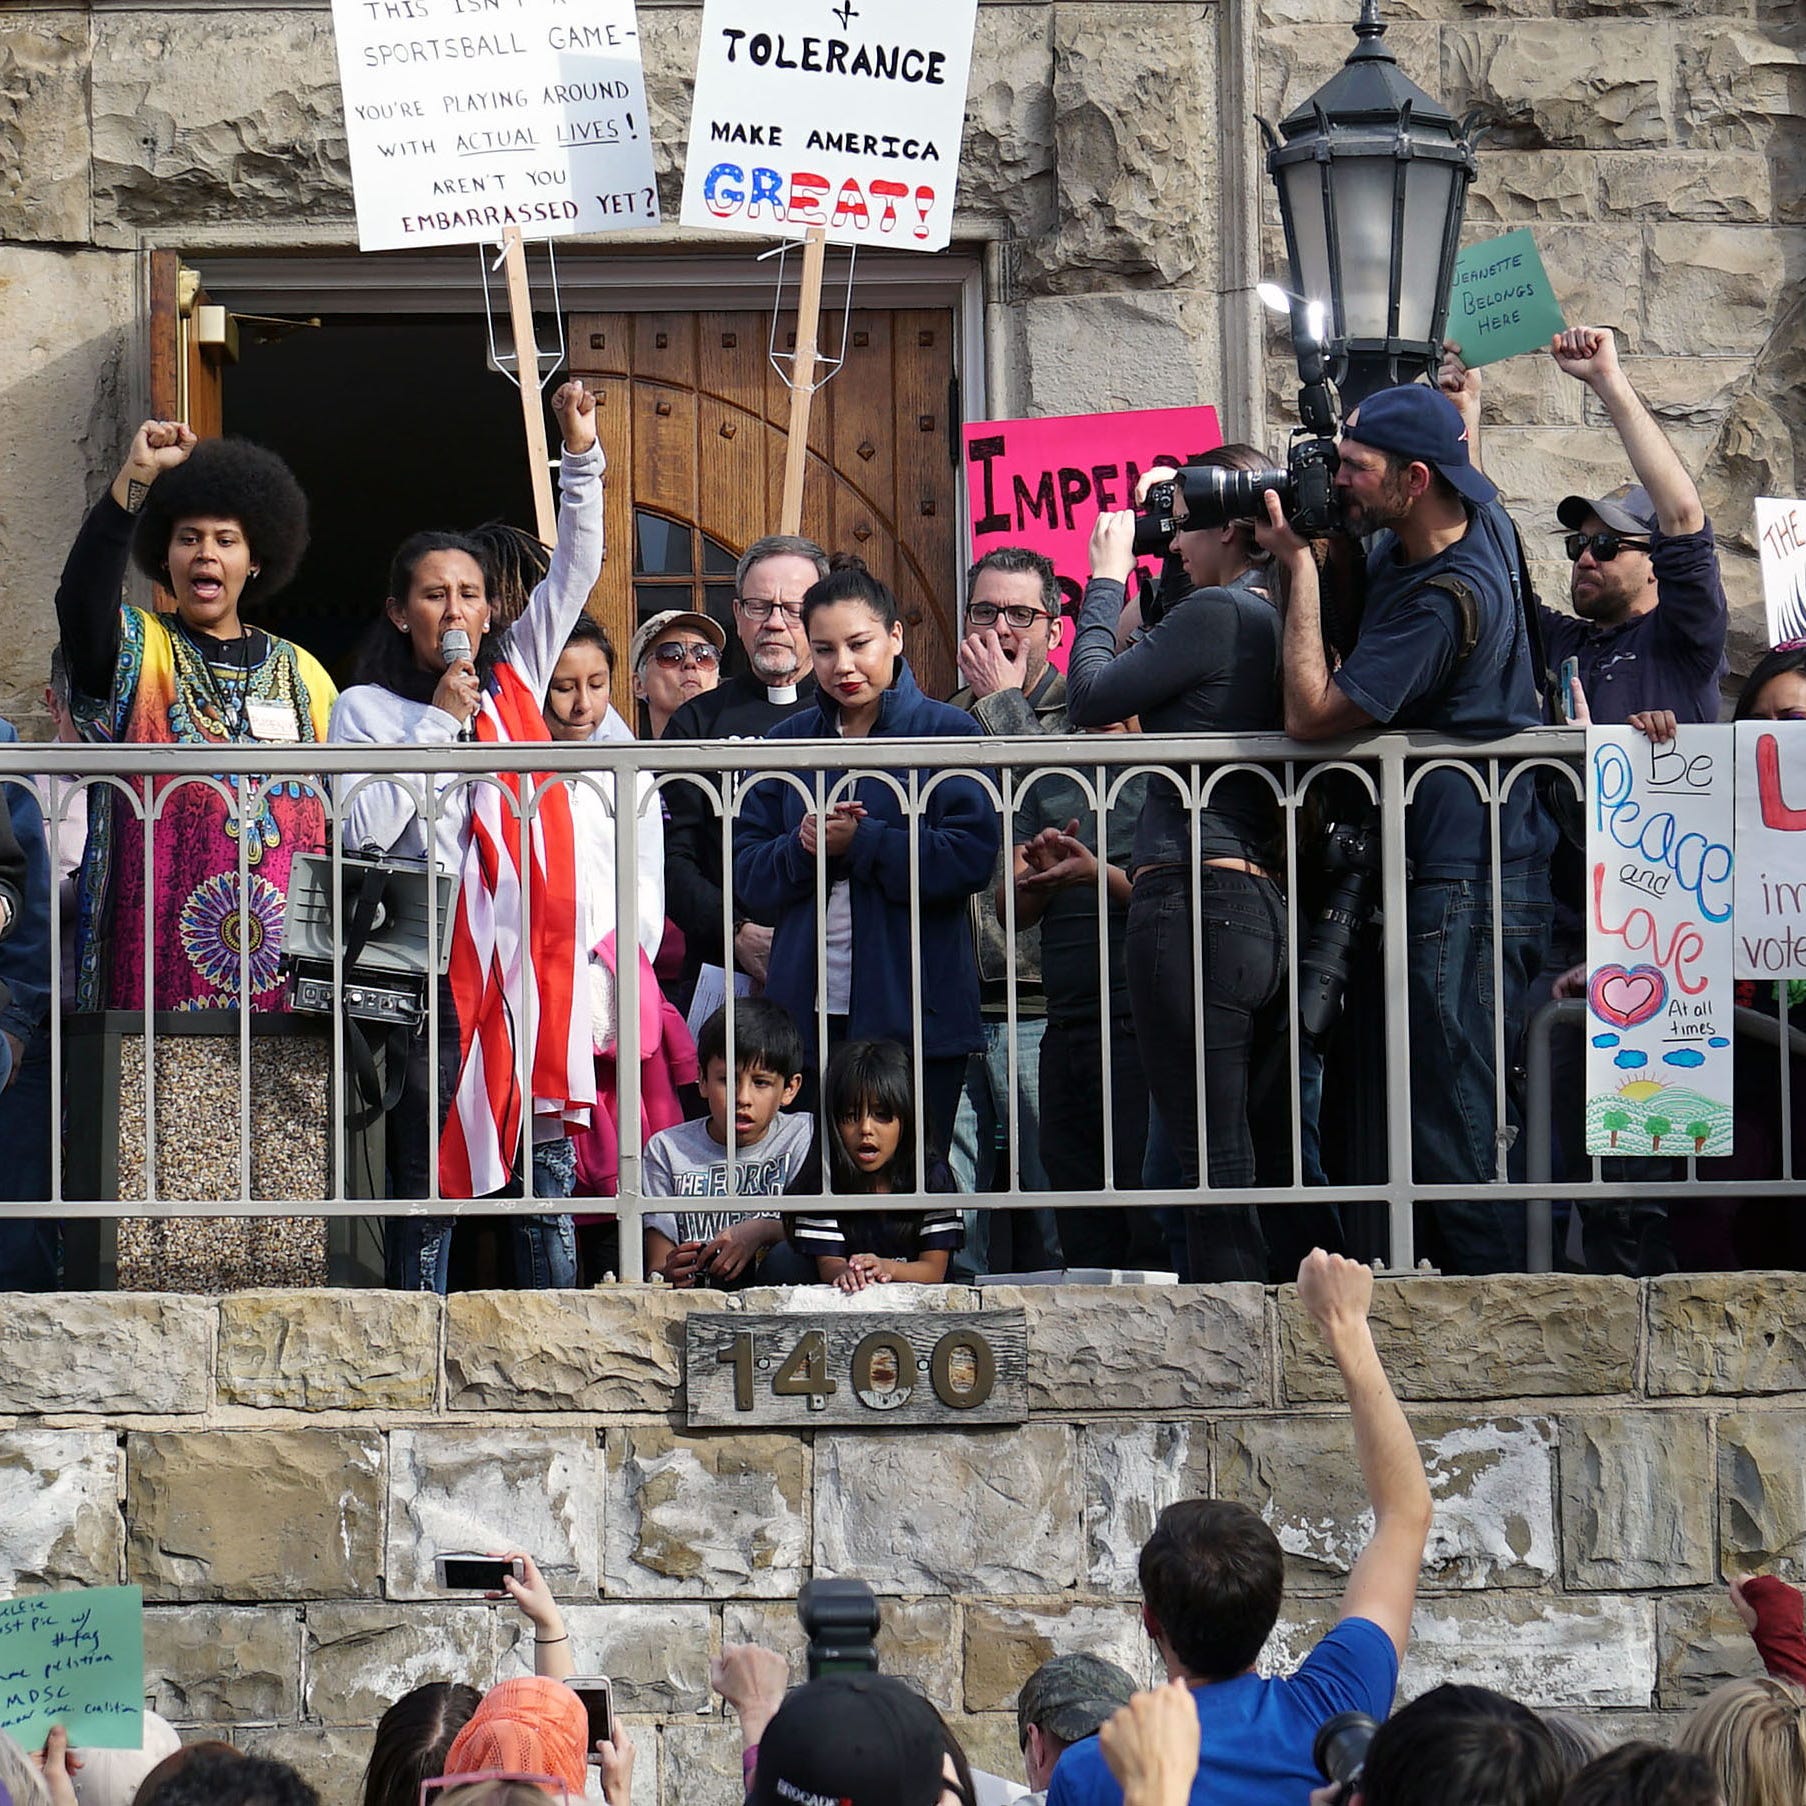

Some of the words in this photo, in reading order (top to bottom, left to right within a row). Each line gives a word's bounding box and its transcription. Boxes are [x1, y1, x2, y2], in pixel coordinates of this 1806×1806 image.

[363, 1, 429, 21] THIS
[364, 33, 528, 67] SPORTSBALL
[721, 28, 946, 85] TOLERANCE
[355, 99, 425, 120] YOU'RE
[443, 89, 529, 114] PLAYING
[543, 80, 630, 105] AROUND
[377, 140, 436, 158] WITH
[456, 127, 540, 152] ACTUAL
[557, 113, 639, 143] LIVES!
[711, 121, 783, 147] MAKE
[806, 130, 940, 161] AMERICA
[433, 173, 507, 195] AREN'T
[526, 168, 567, 187] YOU
[702, 162, 936, 240] GREAT!
[401, 200, 579, 233] EMBARRASSED
[596, 187, 656, 219] YET?
[1463, 283, 1536, 316] BELONGS
[1478, 310, 1522, 336] HERE
[1763, 509, 1805, 560] THE
[1646, 737, 1713, 788] Be
[1594, 743, 1734, 923] Peace
[1619, 863, 1672, 896] and
[1593, 862, 1709, 995] Love
[1668, 999, 1688, 1017] At
[1694, 1000, 1713, 1016] all
[1671, 1020, 1716, 1036] times
[673, 1174, 706, 1195] THE
[717, 1329, 996, 1412] 1400
